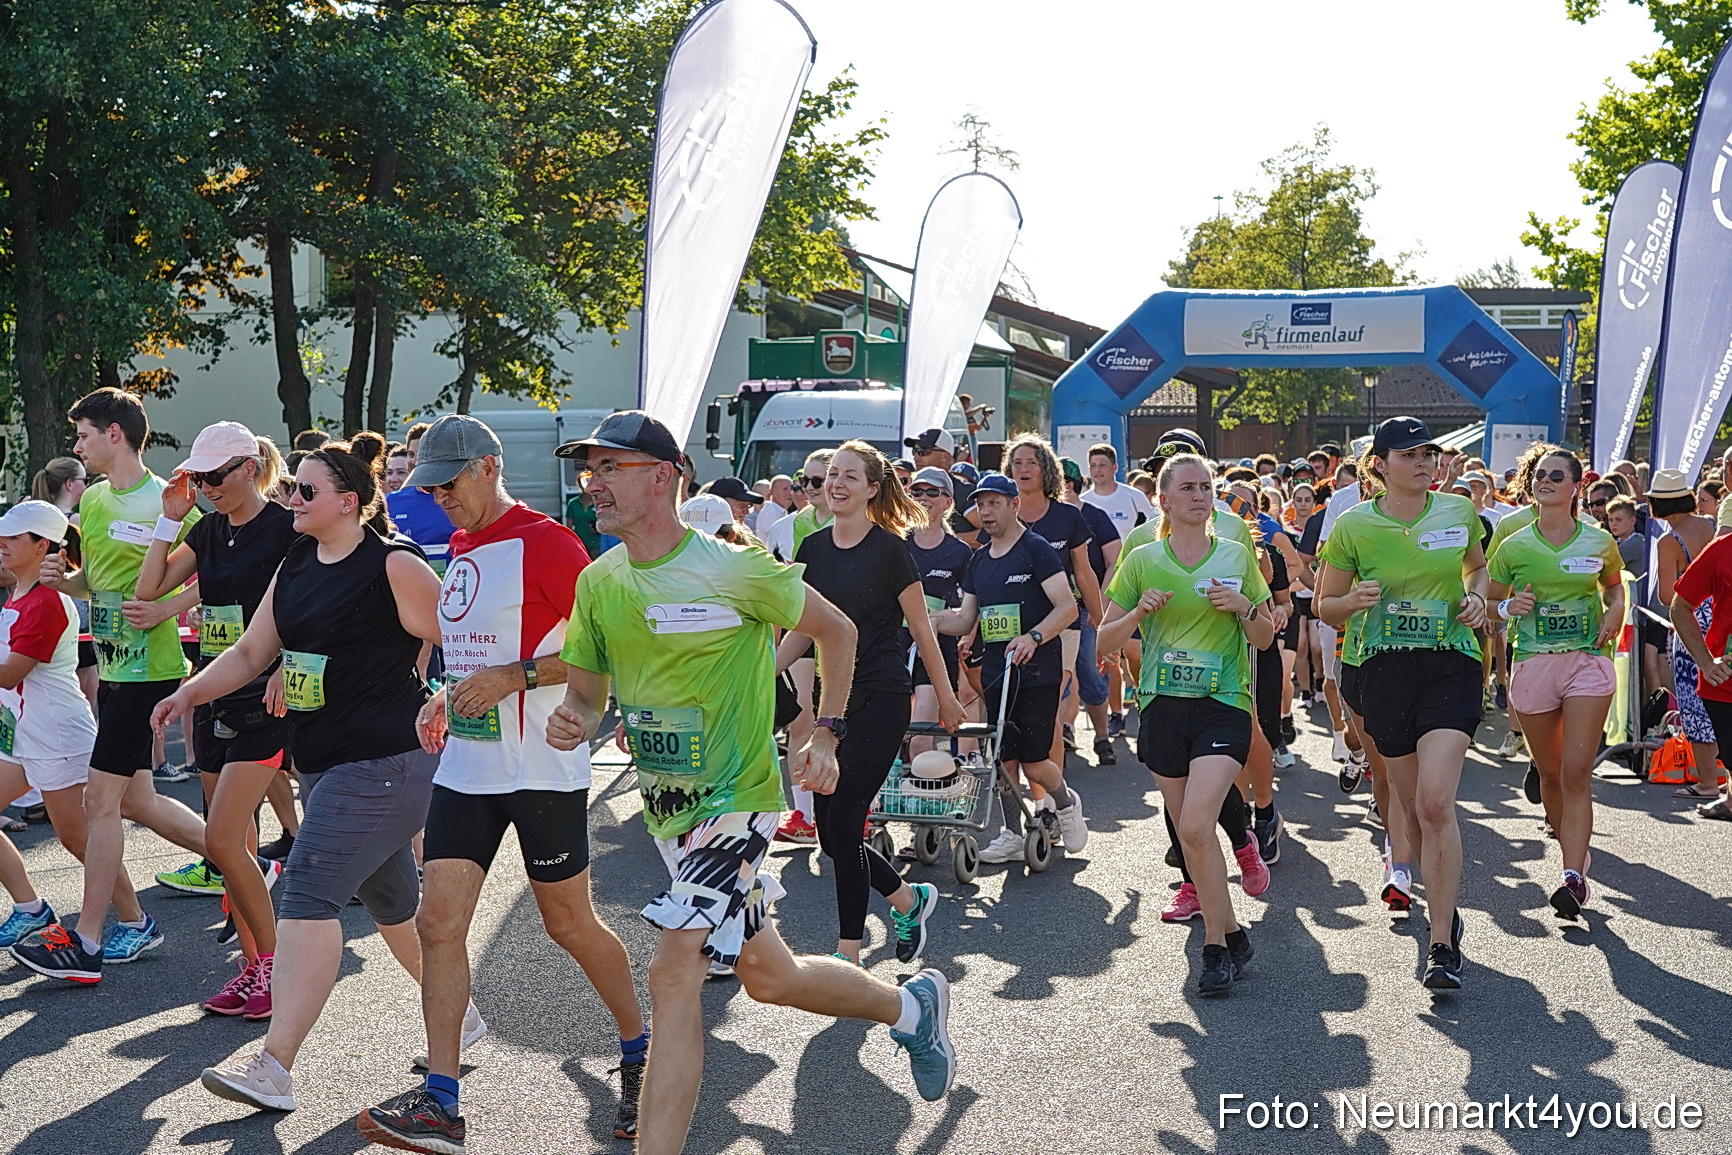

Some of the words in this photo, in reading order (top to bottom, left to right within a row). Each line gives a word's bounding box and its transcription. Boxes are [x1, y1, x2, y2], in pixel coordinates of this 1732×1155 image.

[1631, 187, 1673, 290] Fischer
[1651, 201, 1678, 286] AUTOMOBIL
[1299, 311, 1330, 319] Fischer
[1276, 325, 1366, 344] firmenlauf
[1105, 354, 1154, 366] Fischer
[205, 623, 228, 640] 744
[987, 617, 1008, 631] 890
[1397, 615, 1431, 633] 203
[1548, 615, 1578, 630] 923
[451, 634, 467, 644] MIT
[285, 670, 308, 692] 747
[1159, 668, 1167, 685] RUN
[1171, 664, 1206, 683] 637
[1210, 671, 1219, 693] 2022
[293, 693, 304, 701] Eva
[313, 678, 321, 704] 2022
[0, 720, 9, 739] 3
[467, 722, 485, 730] Josef
[629, 735, 639, 759] RUN
[640, 731, 680, 756] 680
[690, 735, 701, 768] 2022
[660, 756, 689, 766] Robert
[533, 857, 563, 866] JAKO
